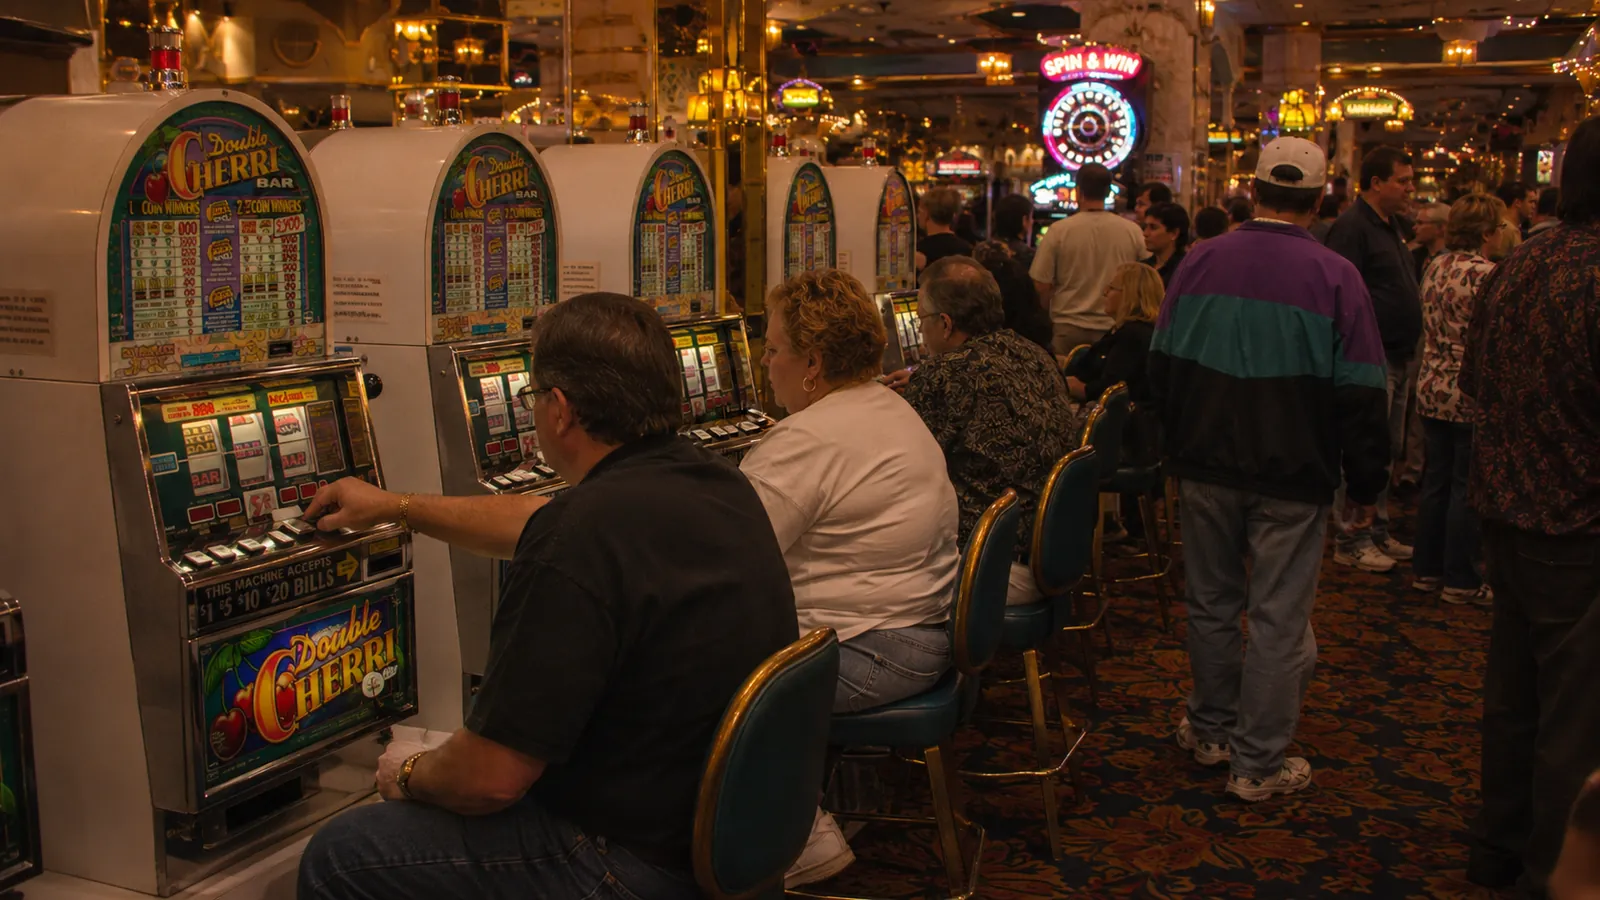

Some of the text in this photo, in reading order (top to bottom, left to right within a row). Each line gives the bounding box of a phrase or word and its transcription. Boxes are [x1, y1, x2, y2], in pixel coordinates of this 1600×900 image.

[1043, 53, 1082, 76] SPIN
[1087, 52, 1099, 69] &
[1104, 53, 1139, 74] WIN
[208, 125, 268, 157] Double
[256, 178, 294, 189] BAR
[516, 190, 538, 199] BAR
[282, 453, 306, 468] BAR
[191, 471, 221, 488] BAR
[205, 556, 332, 599] THIS MACHINE ACCEPTS
[201, 602, 213, 622] $1
[238, 589, 260, 611] $10
[266, 582, 289, 603] $20
[294, 569, 334, 596] BILLS
[289, 599, 382, 674] Double
[253, 628, 397, 744] CHERRI
